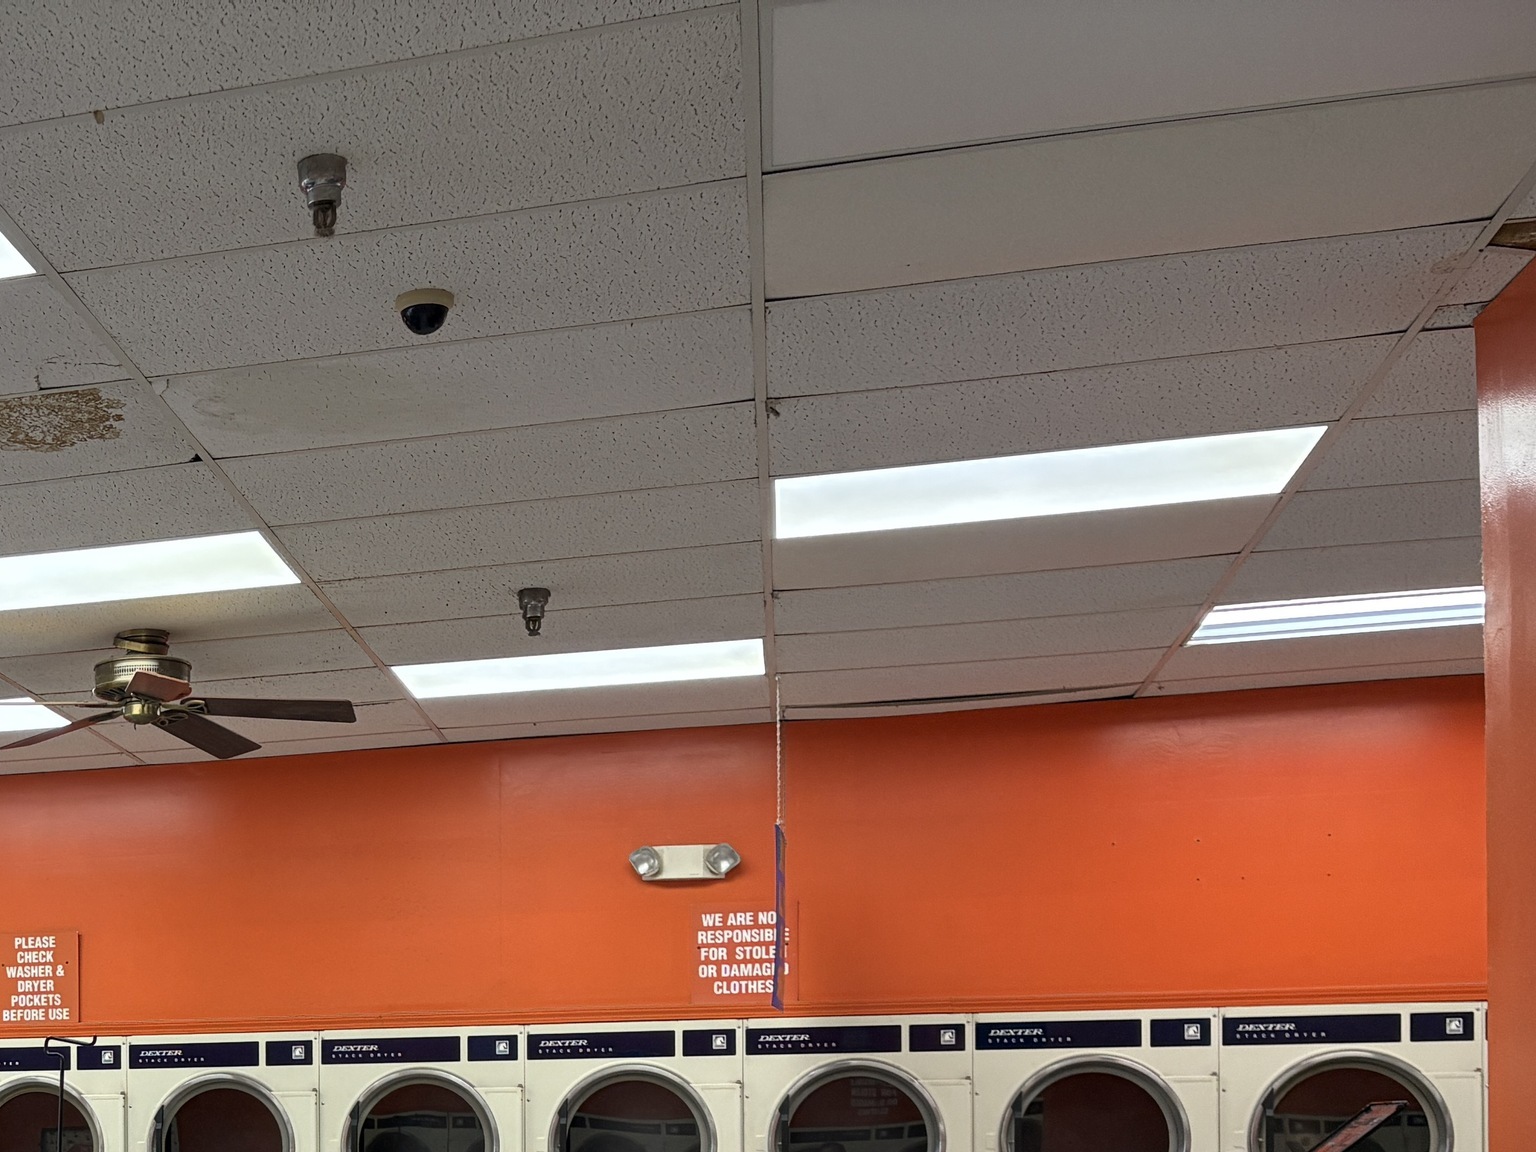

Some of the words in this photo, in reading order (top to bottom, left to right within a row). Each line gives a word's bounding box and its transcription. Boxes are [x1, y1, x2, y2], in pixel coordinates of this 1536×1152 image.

[701, 913, 723, 927] WE
[726, 912, 754, 926] ARE
[758, 911, 777, 925] NO
[14, 936, 56, 949] PLEASE
[17, 951, 54, 963] CHECK
[700, 947, 727, 961] FOR
[6, 965, 53, 978] WASHER
[56, 964, 65, 977] &
[698, 964, 717, 978] OR
[17, 980, 55, 992] DRYER
[713, 980, 774, 995] CLOTHES
[11, 994, 62, 1007] POCKETS
[2, 1009, 46, 1021] BEFORE
[49, 1008, 70, 1020] USE
[987, 1028, 1044, 1036] DEXTER
[1235, 1022, 1297, 1031] DEXTER
[538, 1039, 589, 1047] DEXTER
[757, 1034, 811, 1042] DEXTER
[138, 1049, 183, 1057] DEXTER
[332, 1044, 379, 1052] DEXTER
